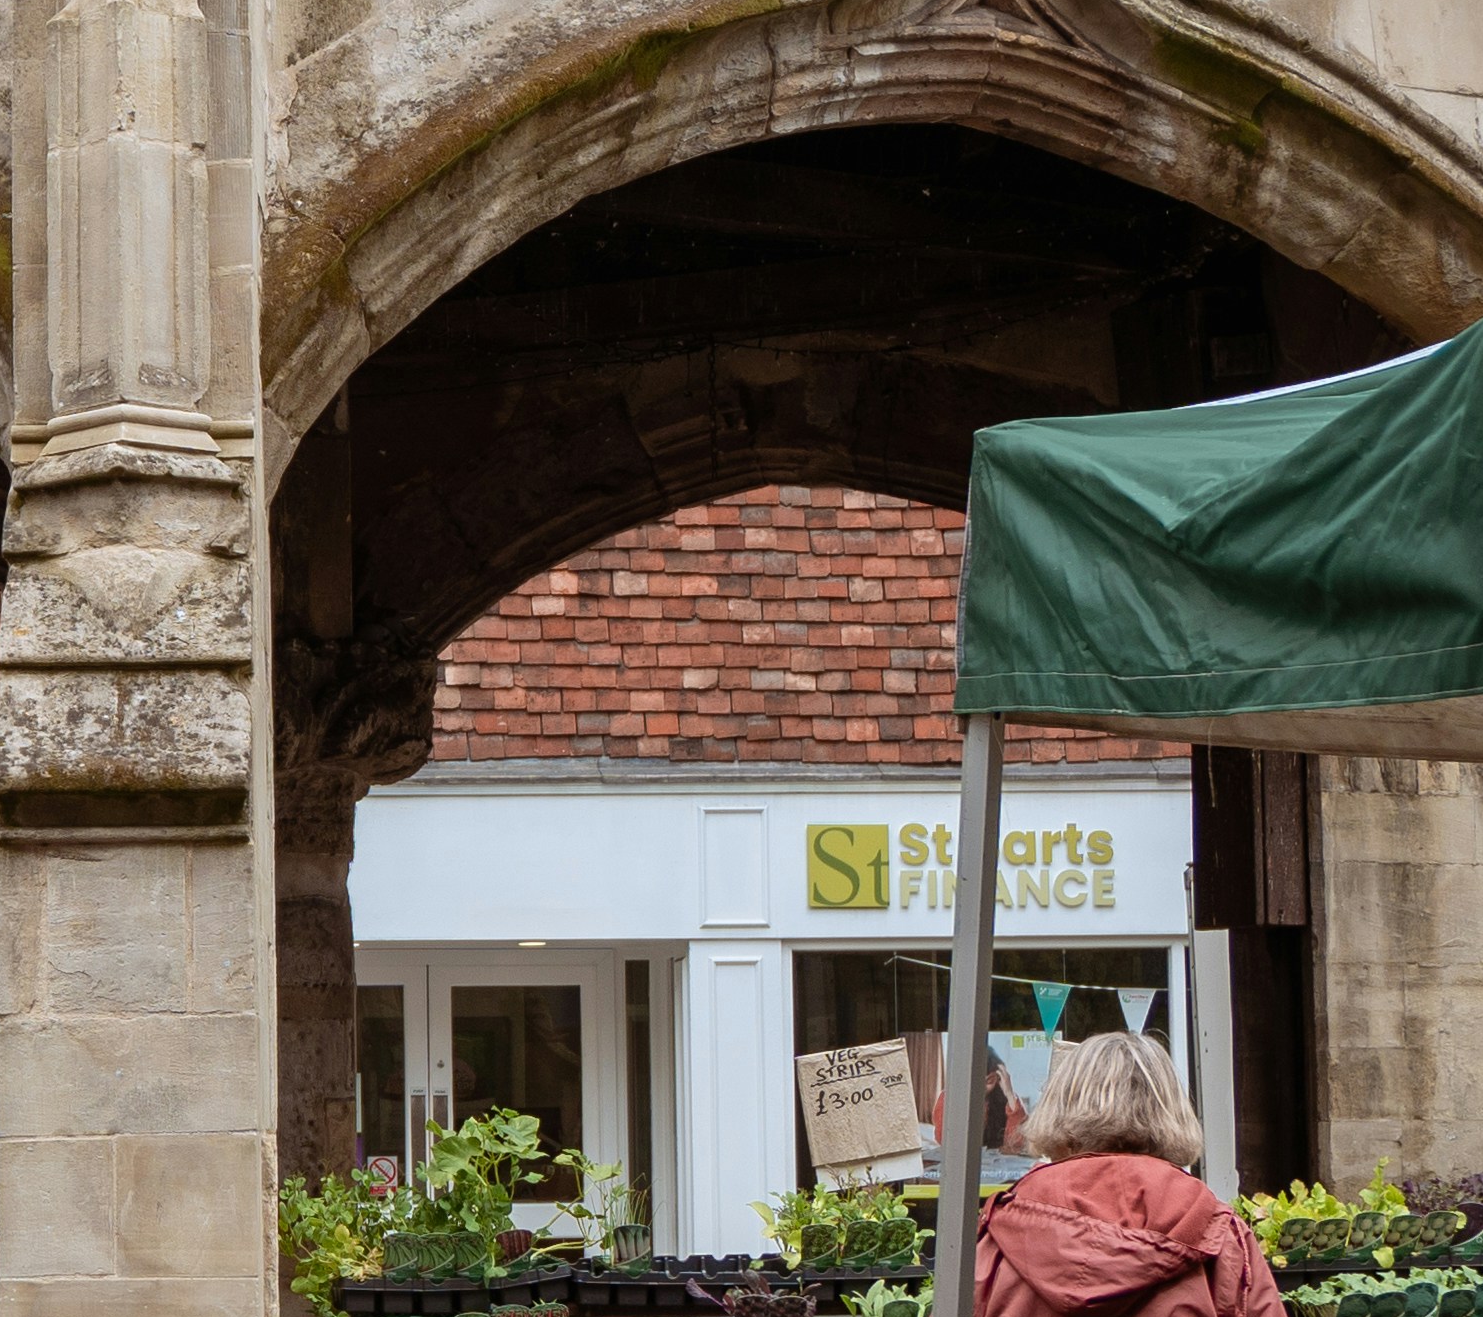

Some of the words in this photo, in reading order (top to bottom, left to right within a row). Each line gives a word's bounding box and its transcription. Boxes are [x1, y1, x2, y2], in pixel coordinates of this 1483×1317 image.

[898, 822, 954, 865] St
[998, 822, 1115, 865] arts
[815, 1058, 877, 1082] STRIPS
[824, 1047, 860, 1067] VEG
[814, 1086, 874, 1117] £3.00
